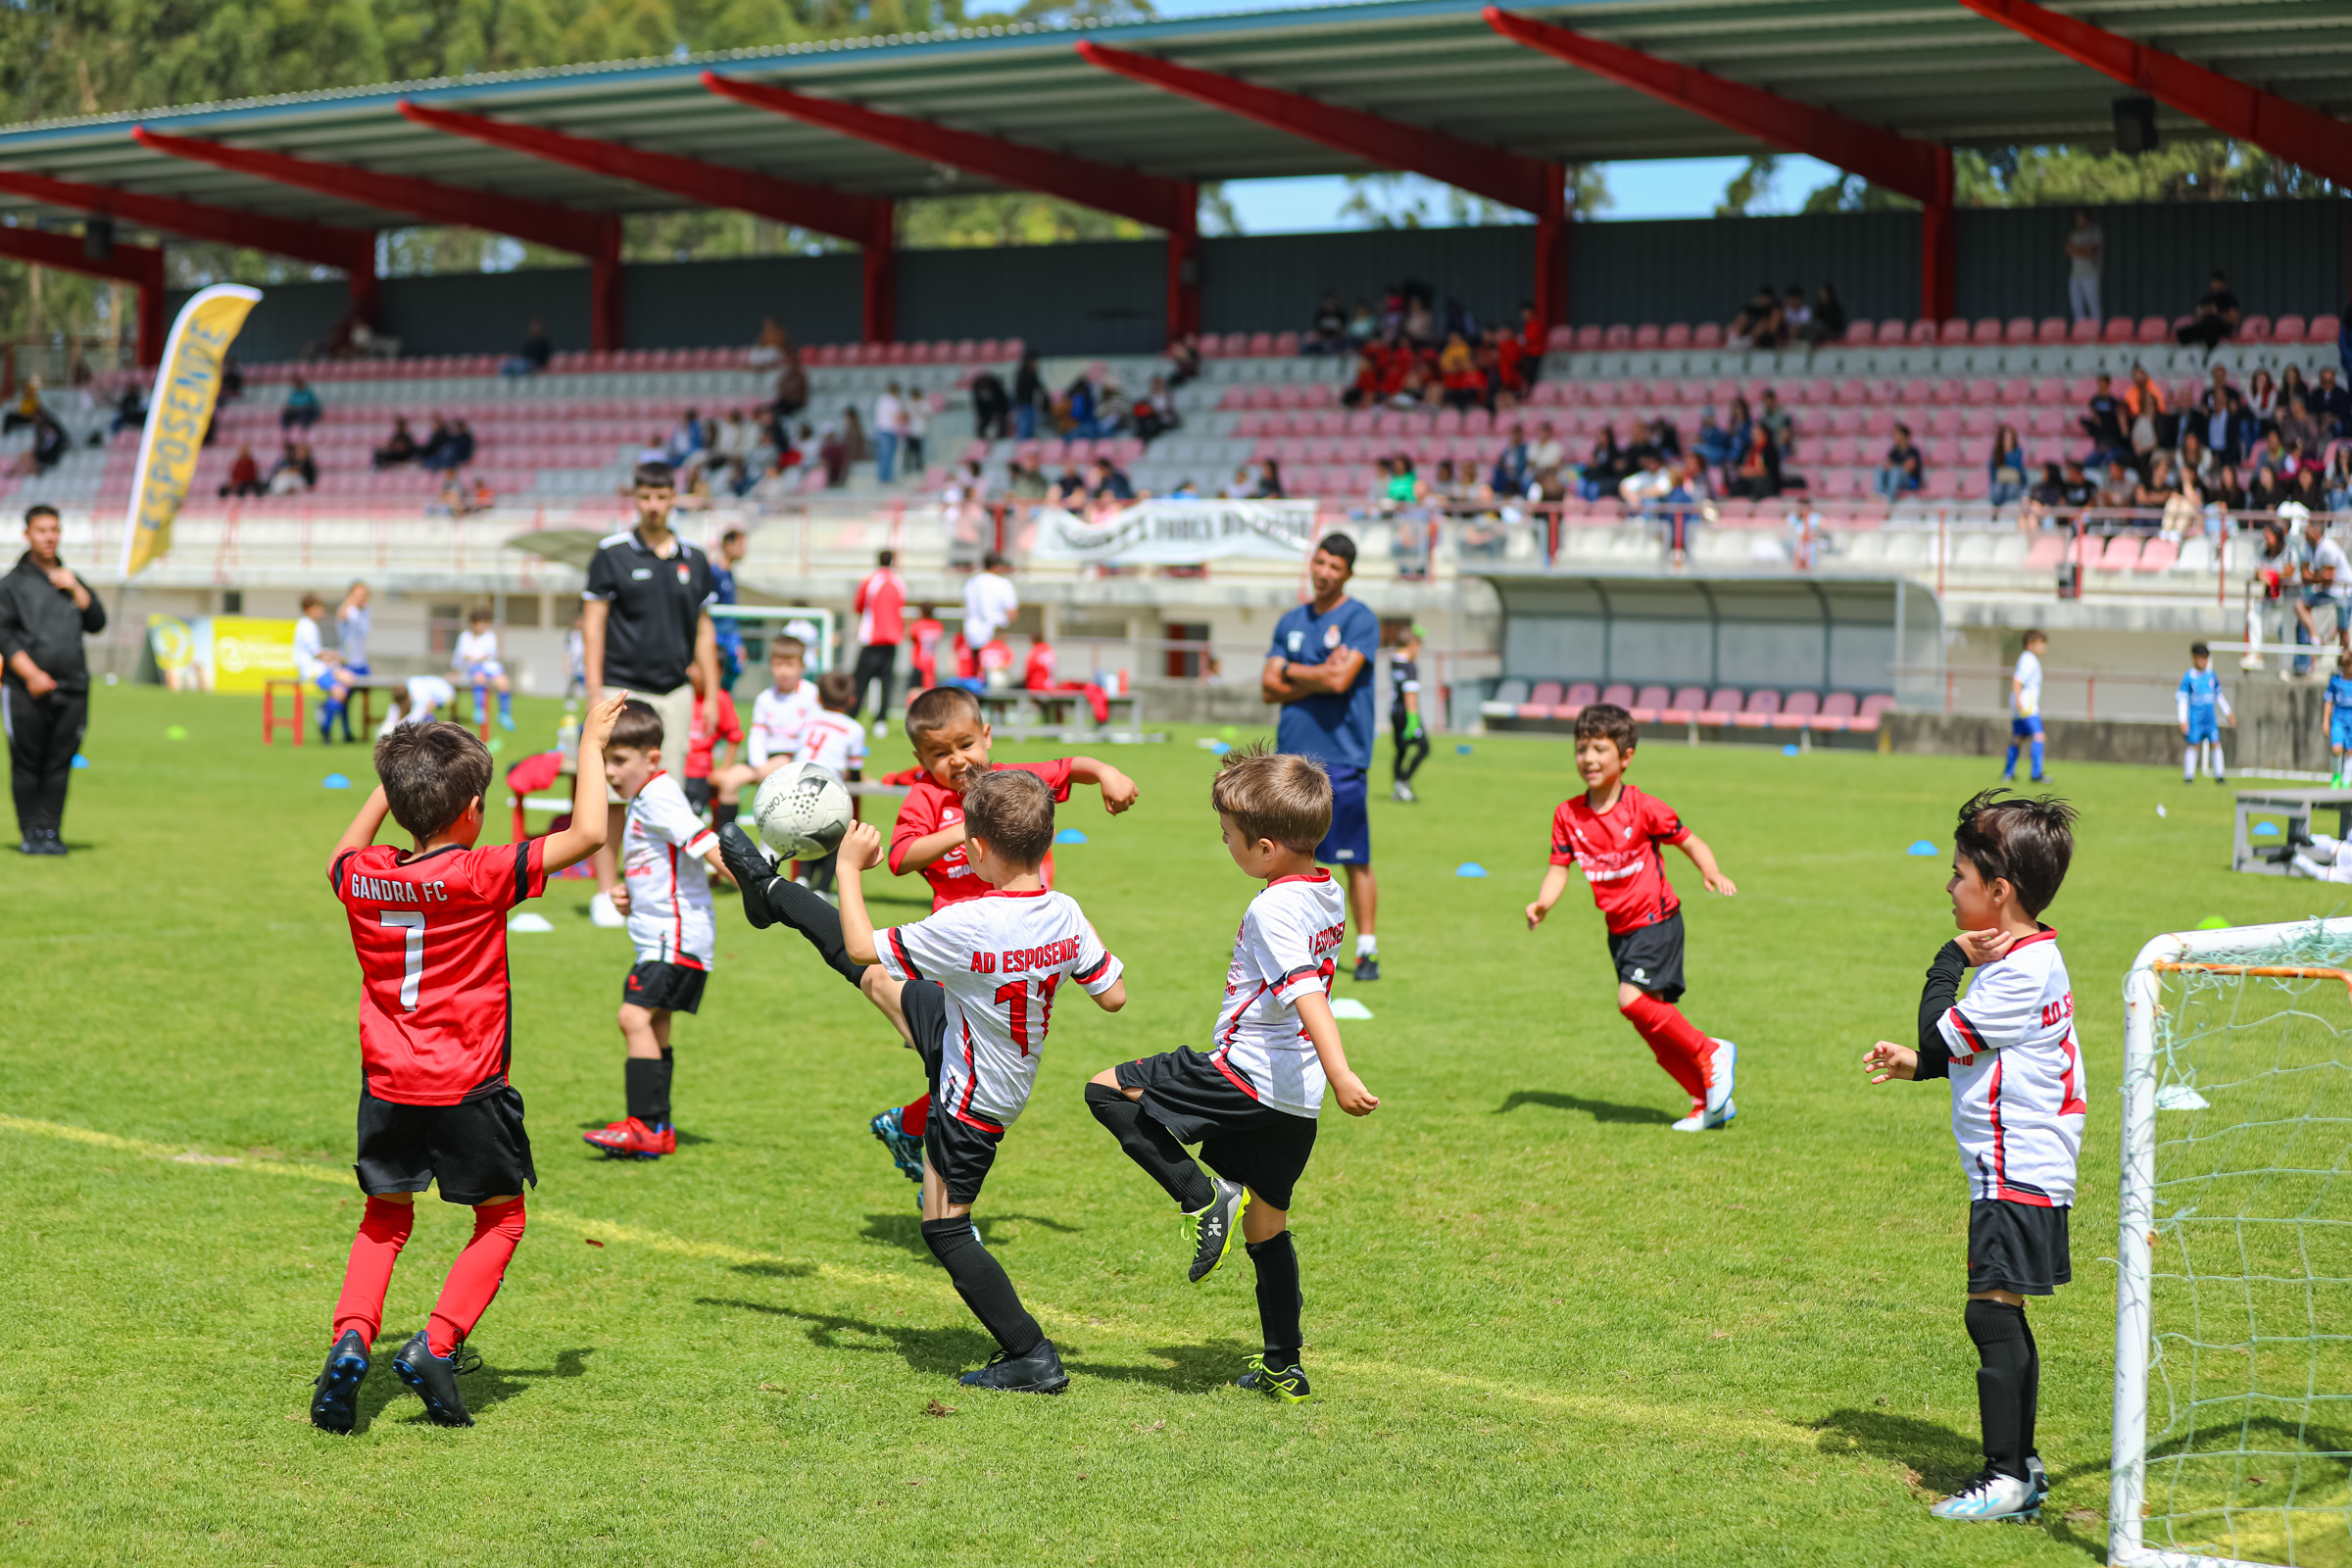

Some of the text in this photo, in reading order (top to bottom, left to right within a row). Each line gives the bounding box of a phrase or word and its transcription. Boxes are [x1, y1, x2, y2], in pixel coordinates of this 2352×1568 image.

[140, 318, 228, 531] ESPOSENDE
[805, 728, 827, 760] 4
[351, 872, 449, 904] GANDRA FC
[379, 909, 426, 1012] 7
[969, 934, 1081, 975] AD ESPOSENDE
[993, 972, 1061, 1059] 11
[2040, 1001, 2062, 1030] AD
